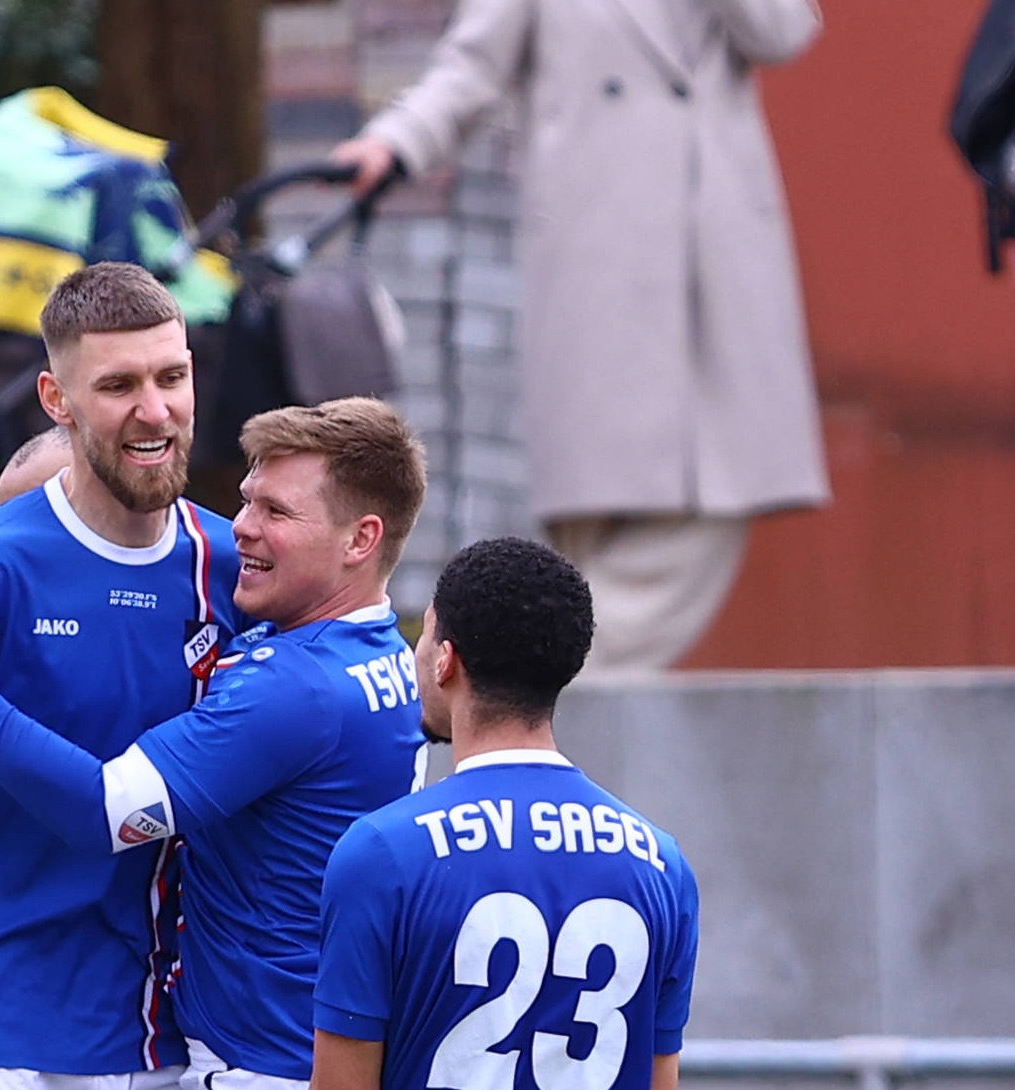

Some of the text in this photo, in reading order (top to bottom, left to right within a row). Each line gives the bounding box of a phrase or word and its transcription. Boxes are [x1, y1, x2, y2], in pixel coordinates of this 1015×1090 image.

[32, 618, 80, 637] JAKO
[189, 628, 210, 658] TSV
[345, 644, 421, 712] TSV S
[135, 816, 163, 835] TSV
[414, 799, 666, 874] TSV SASEL
